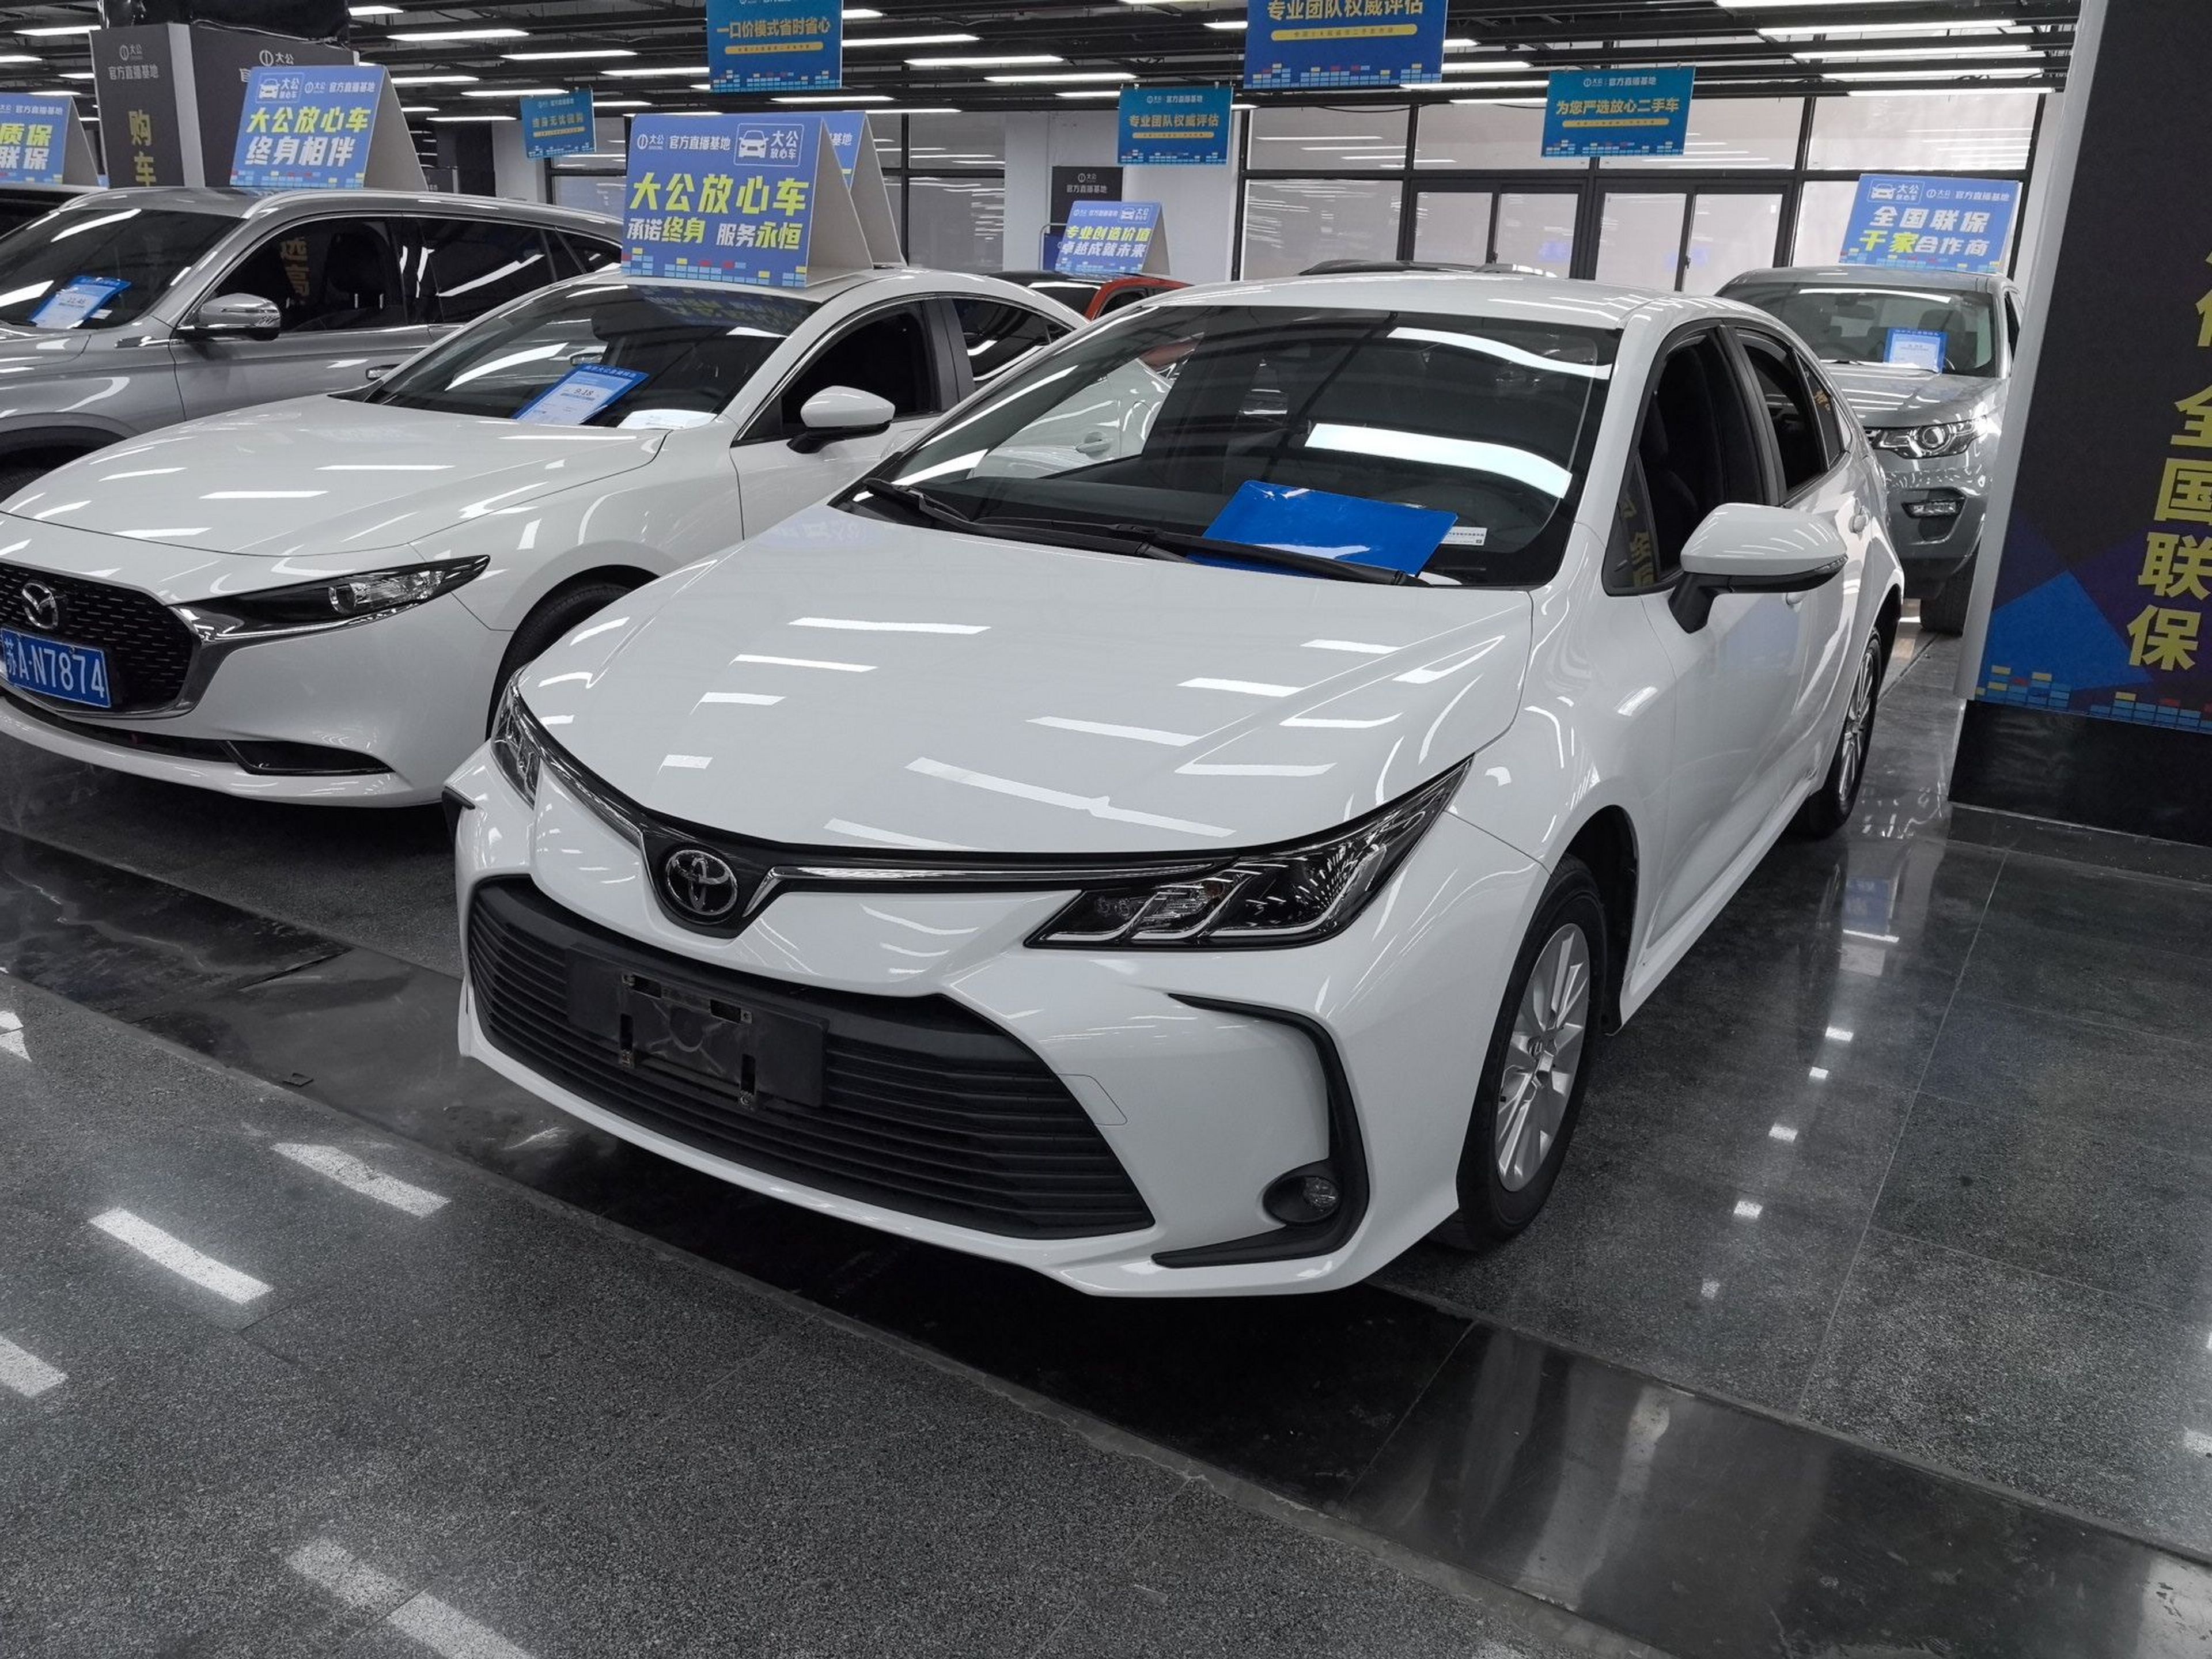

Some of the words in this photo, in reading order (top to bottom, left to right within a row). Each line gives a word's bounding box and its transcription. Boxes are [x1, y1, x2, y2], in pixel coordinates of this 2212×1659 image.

[1267, 0, 1423, 21] 专业团队权威评估
[717, 17, 830, 38] 一口价模式省时省心
[275, 52, 294, 65] 大公
[108, 64, 159, 80] 官方直播基地
[280, 78, 300, 89] 大公
[1556, 98, 1679, 115] 为您严选放心二手车
[247, 107, 371, 133] 大公放心车
[1129, 113, 1219, 127] 专业团队权威评估
[0, 123, 52, 146] 质保
[649, 134, 664, 145] 大公
[669, 135, 731, 150] 官方直播基地
[771, 130, 799, 147] 大公
[128, 109, 157, 187] 购车
[245, 136, 356, 167] 终身相伴
[770, 148, 797, 160] 放心车
[630, 172, 809, 216] 大公放心车
[1897, 184, 1920, 195] 大公
[1955, 191, 2010, 201] 官方直播基地
[1869, 206, 1990, 233] 全国联保
[627, 217, 706, 243] 承诺终身
[716, 221, 802, 249] 服务永恒
[1066, 225, 1152, 242] 专业创造价值
[1061, 241, 1147, 257] 卓越成就未来
[1859, 230, 1990, 257] 千家合作商
